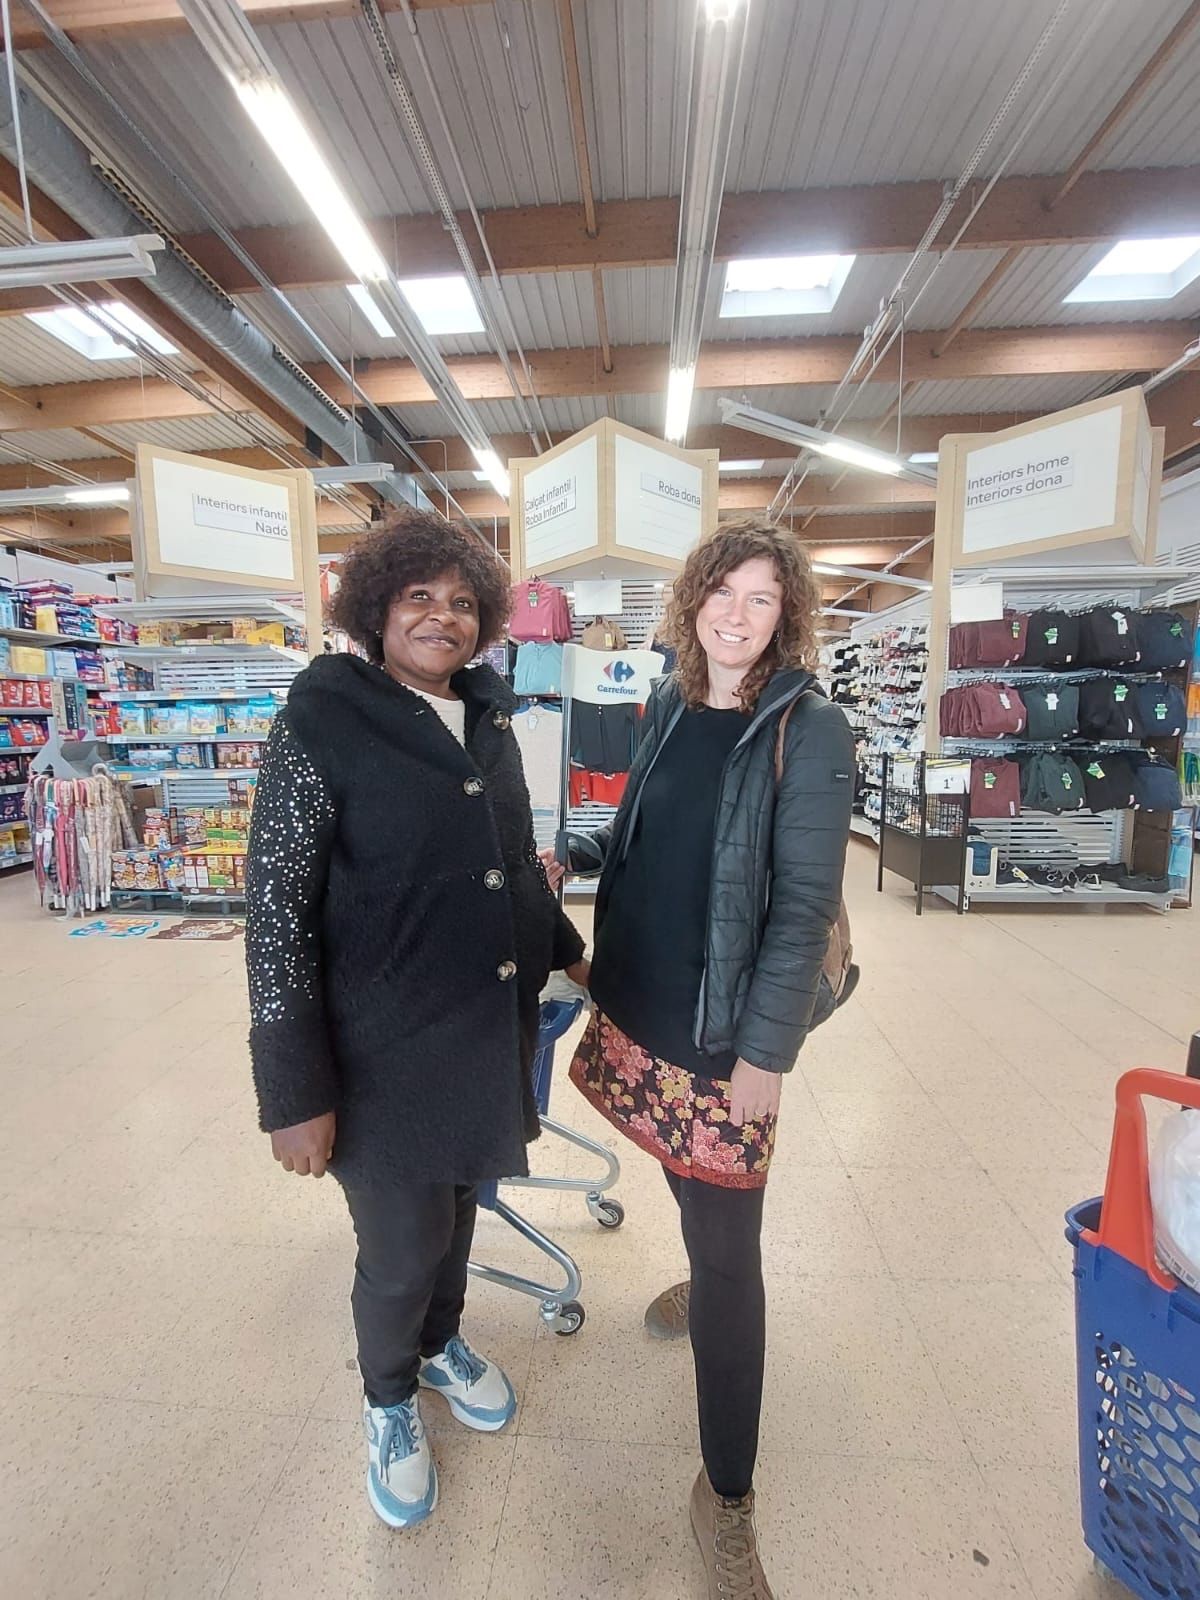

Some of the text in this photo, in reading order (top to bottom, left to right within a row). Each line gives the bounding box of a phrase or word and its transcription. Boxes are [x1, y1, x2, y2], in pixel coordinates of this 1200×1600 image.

[968, 455, 1069, 490] Interiors home
[546, 479, 571, 501] infantil
[658, 480, 701, 505] Roba dona
[967, 473, 1063, 506] Interiors dona
[197, 495, 287, 521] Interiors infantil
[526, 509, 543, 526] Roba
[255, 521, 288, 537] Nadó
[597, 684, 638, 695] Carrefour
